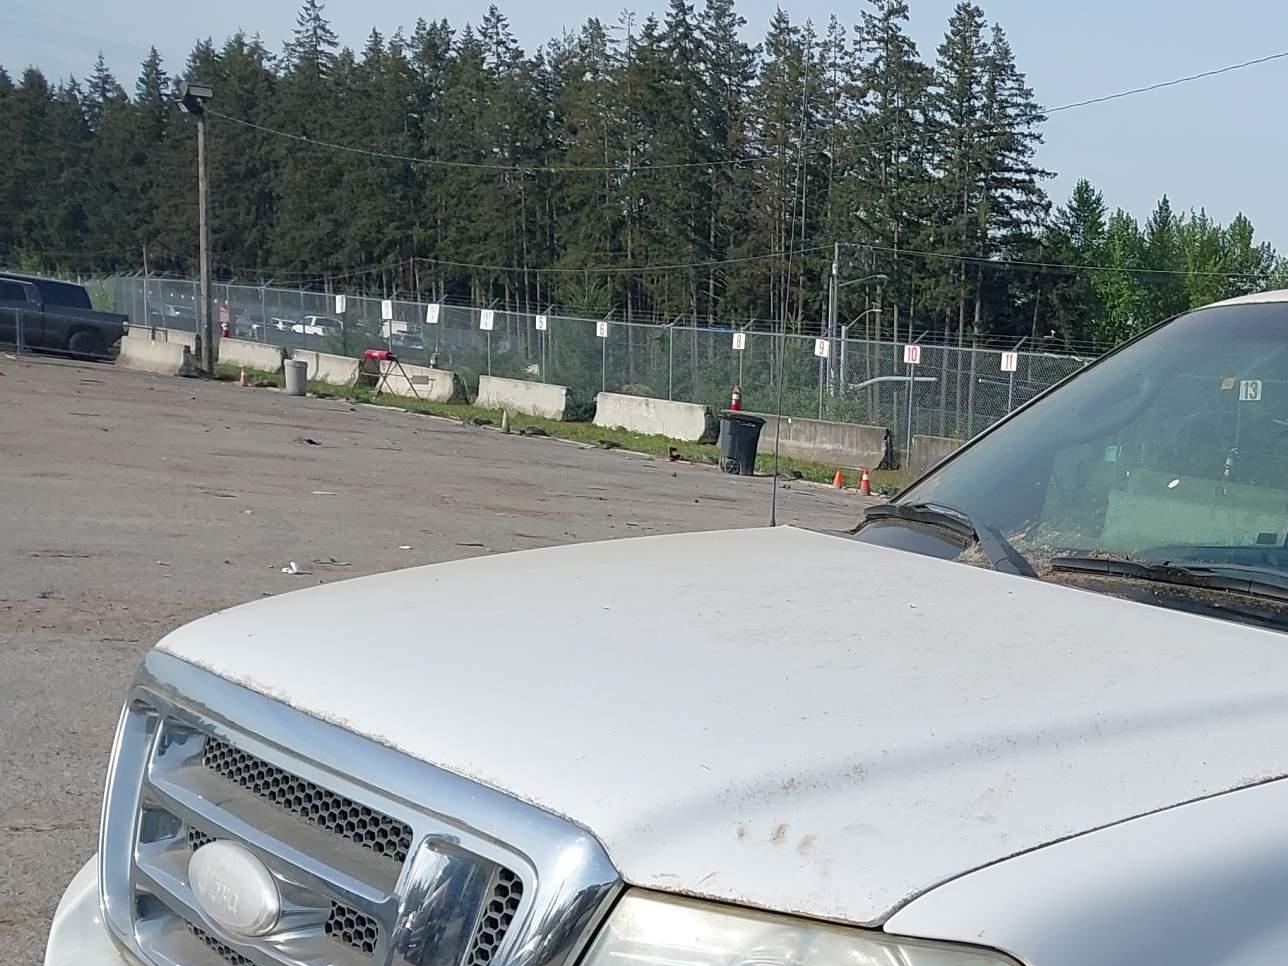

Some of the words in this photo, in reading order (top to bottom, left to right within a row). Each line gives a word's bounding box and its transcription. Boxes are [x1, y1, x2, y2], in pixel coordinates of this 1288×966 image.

[907, 346, 918, 362] 10
[1005, 354, 1014, 370] 11
[1244, 381, 1259, 399] 13
